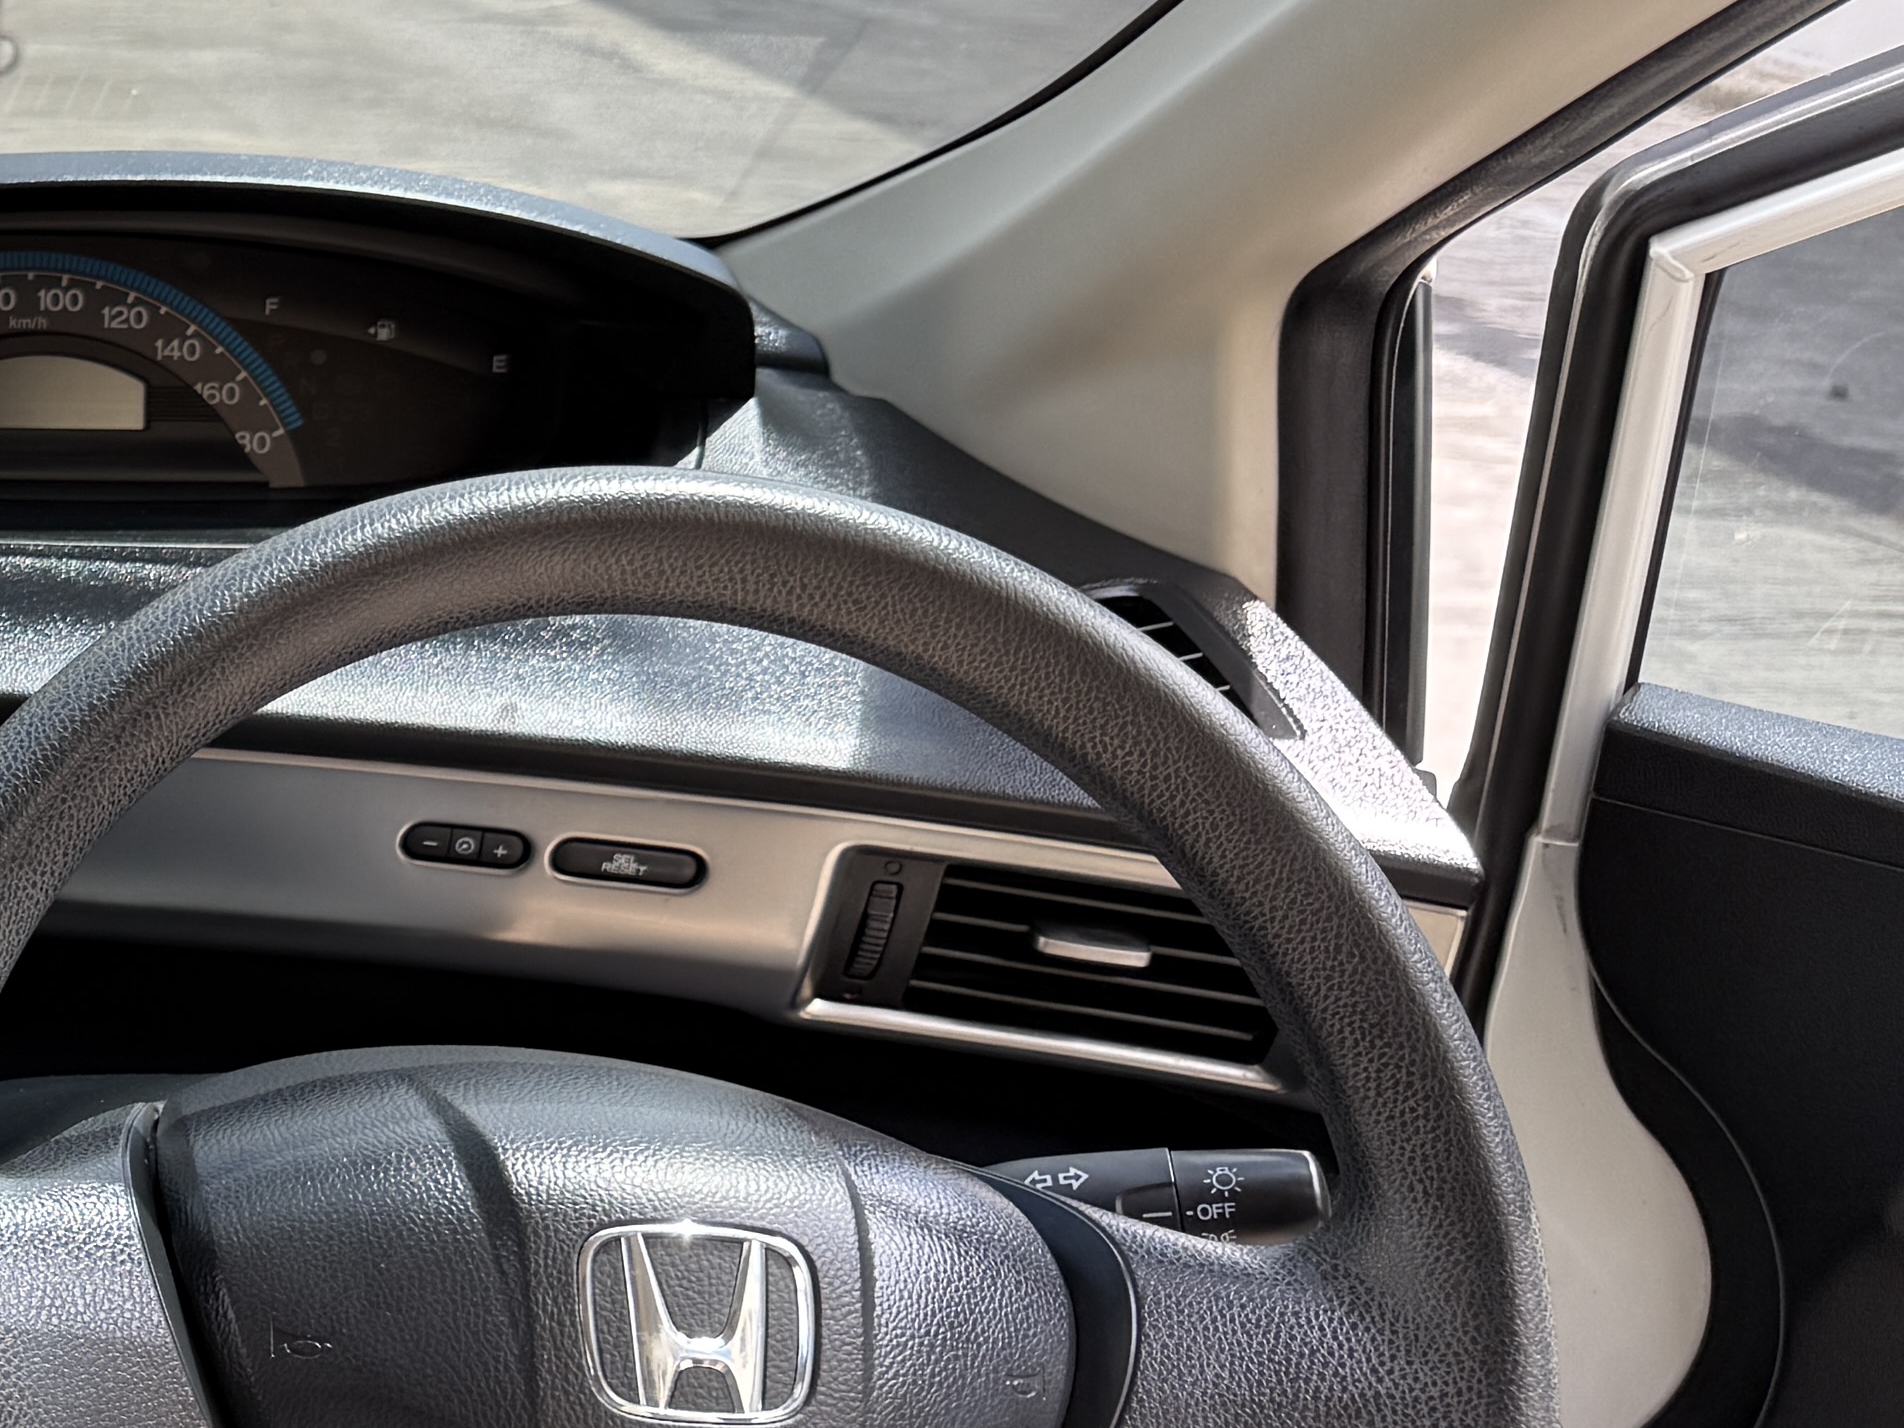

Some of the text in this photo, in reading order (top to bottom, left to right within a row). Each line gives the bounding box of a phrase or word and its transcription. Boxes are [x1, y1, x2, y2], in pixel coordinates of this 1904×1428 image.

[265, 297, 279, 316] F
[9, 315, 47, 330] km/h
[37, 288, 83, 312] 100
[100, 306, 148, 329] 120
[154, 339, 200, 362] 140
[493, 355, 507, 373] E
[601, 862, 648, 876] RESET
[1197, 1202, 1236, 1220] OFF
